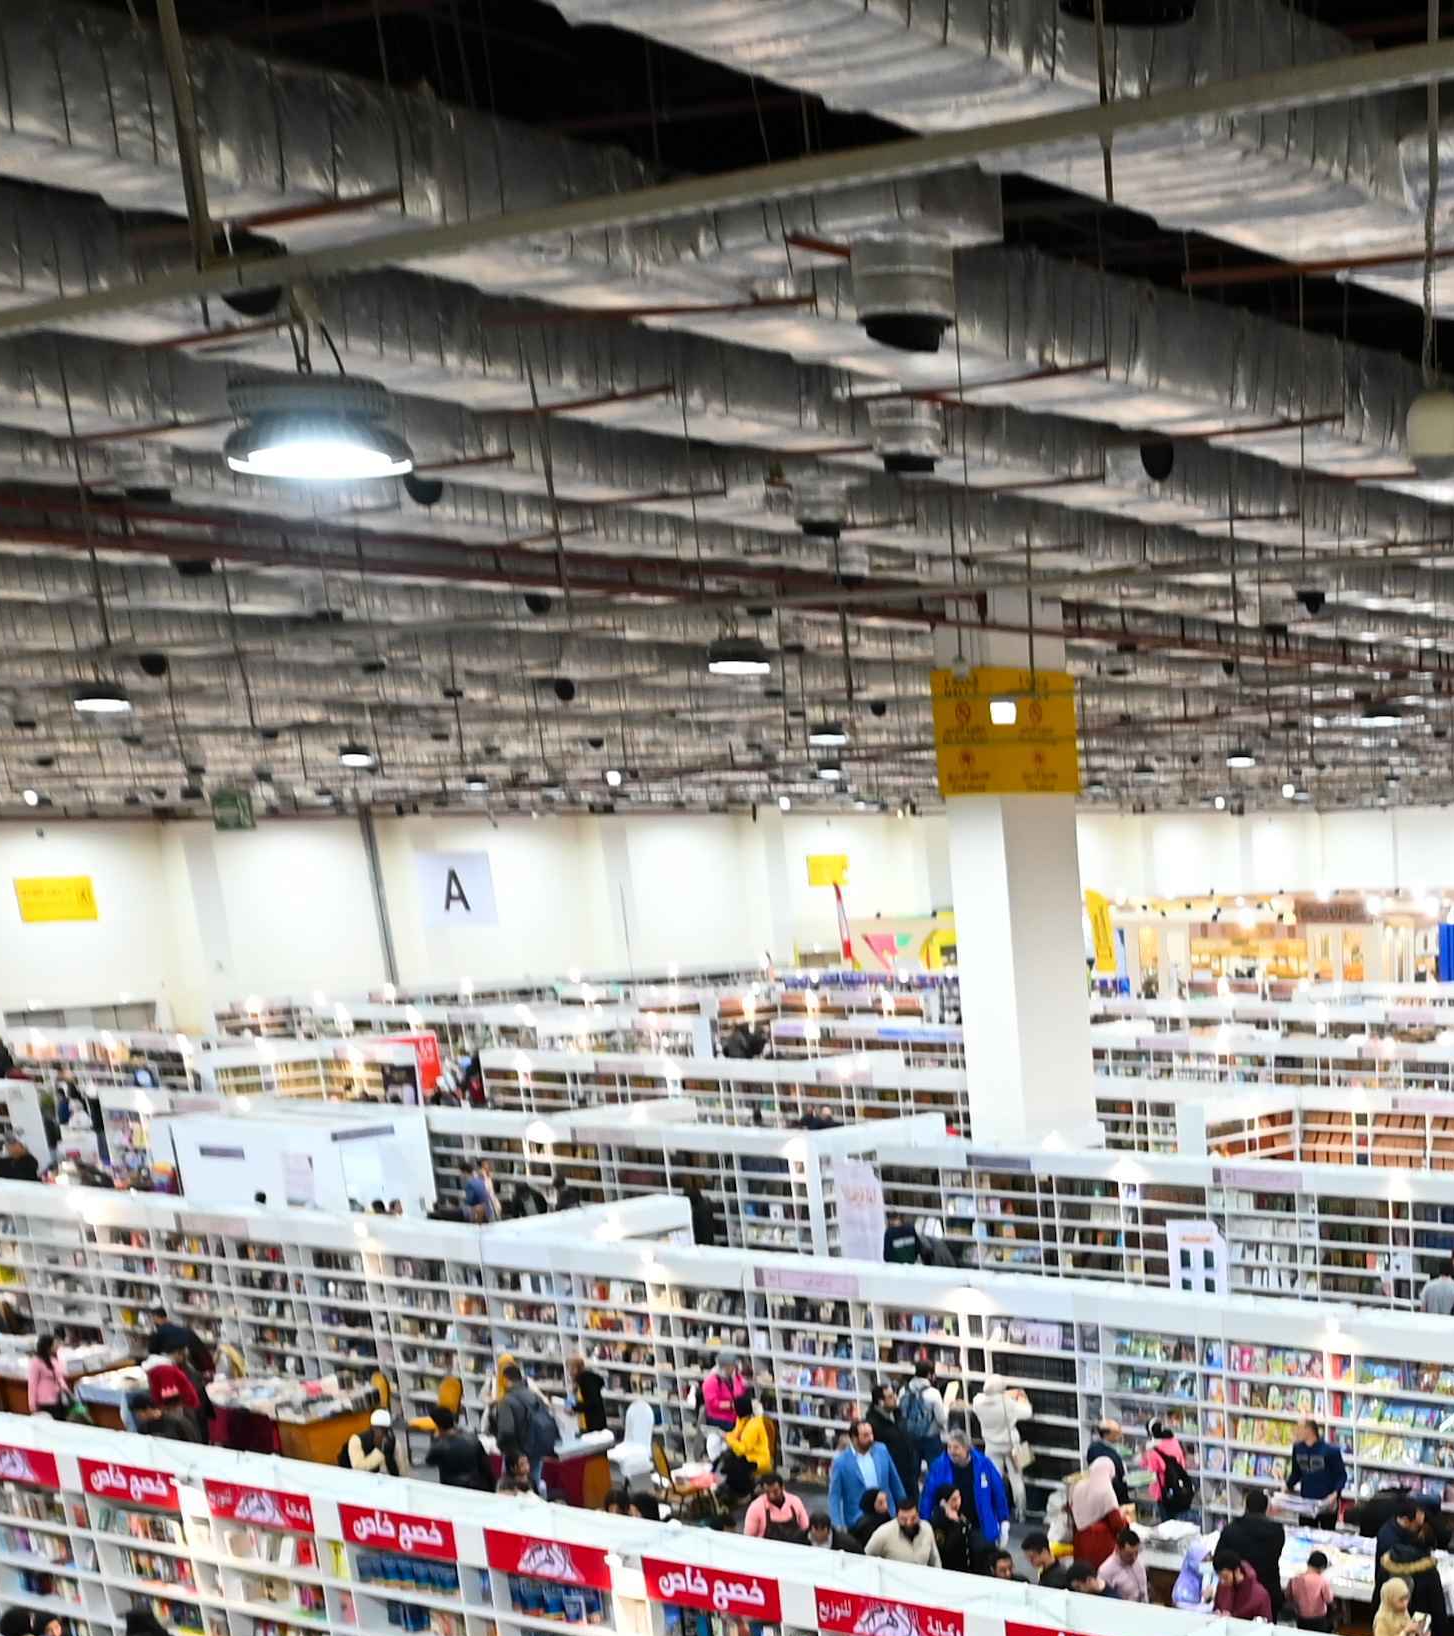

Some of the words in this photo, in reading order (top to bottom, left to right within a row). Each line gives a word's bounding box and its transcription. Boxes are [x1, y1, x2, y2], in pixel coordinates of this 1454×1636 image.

[444, 868, 471, 912] A
[90, 1464, 127, 1491] خاص
[129, 1473, 168, 1500] خصم
[353, 1511, 394, 1540] خاص
[399, 1519, 443, 1552] خصم
[658, 1565, 708, 1598] خاص
[711, 1577, 766, 1611] خصم
